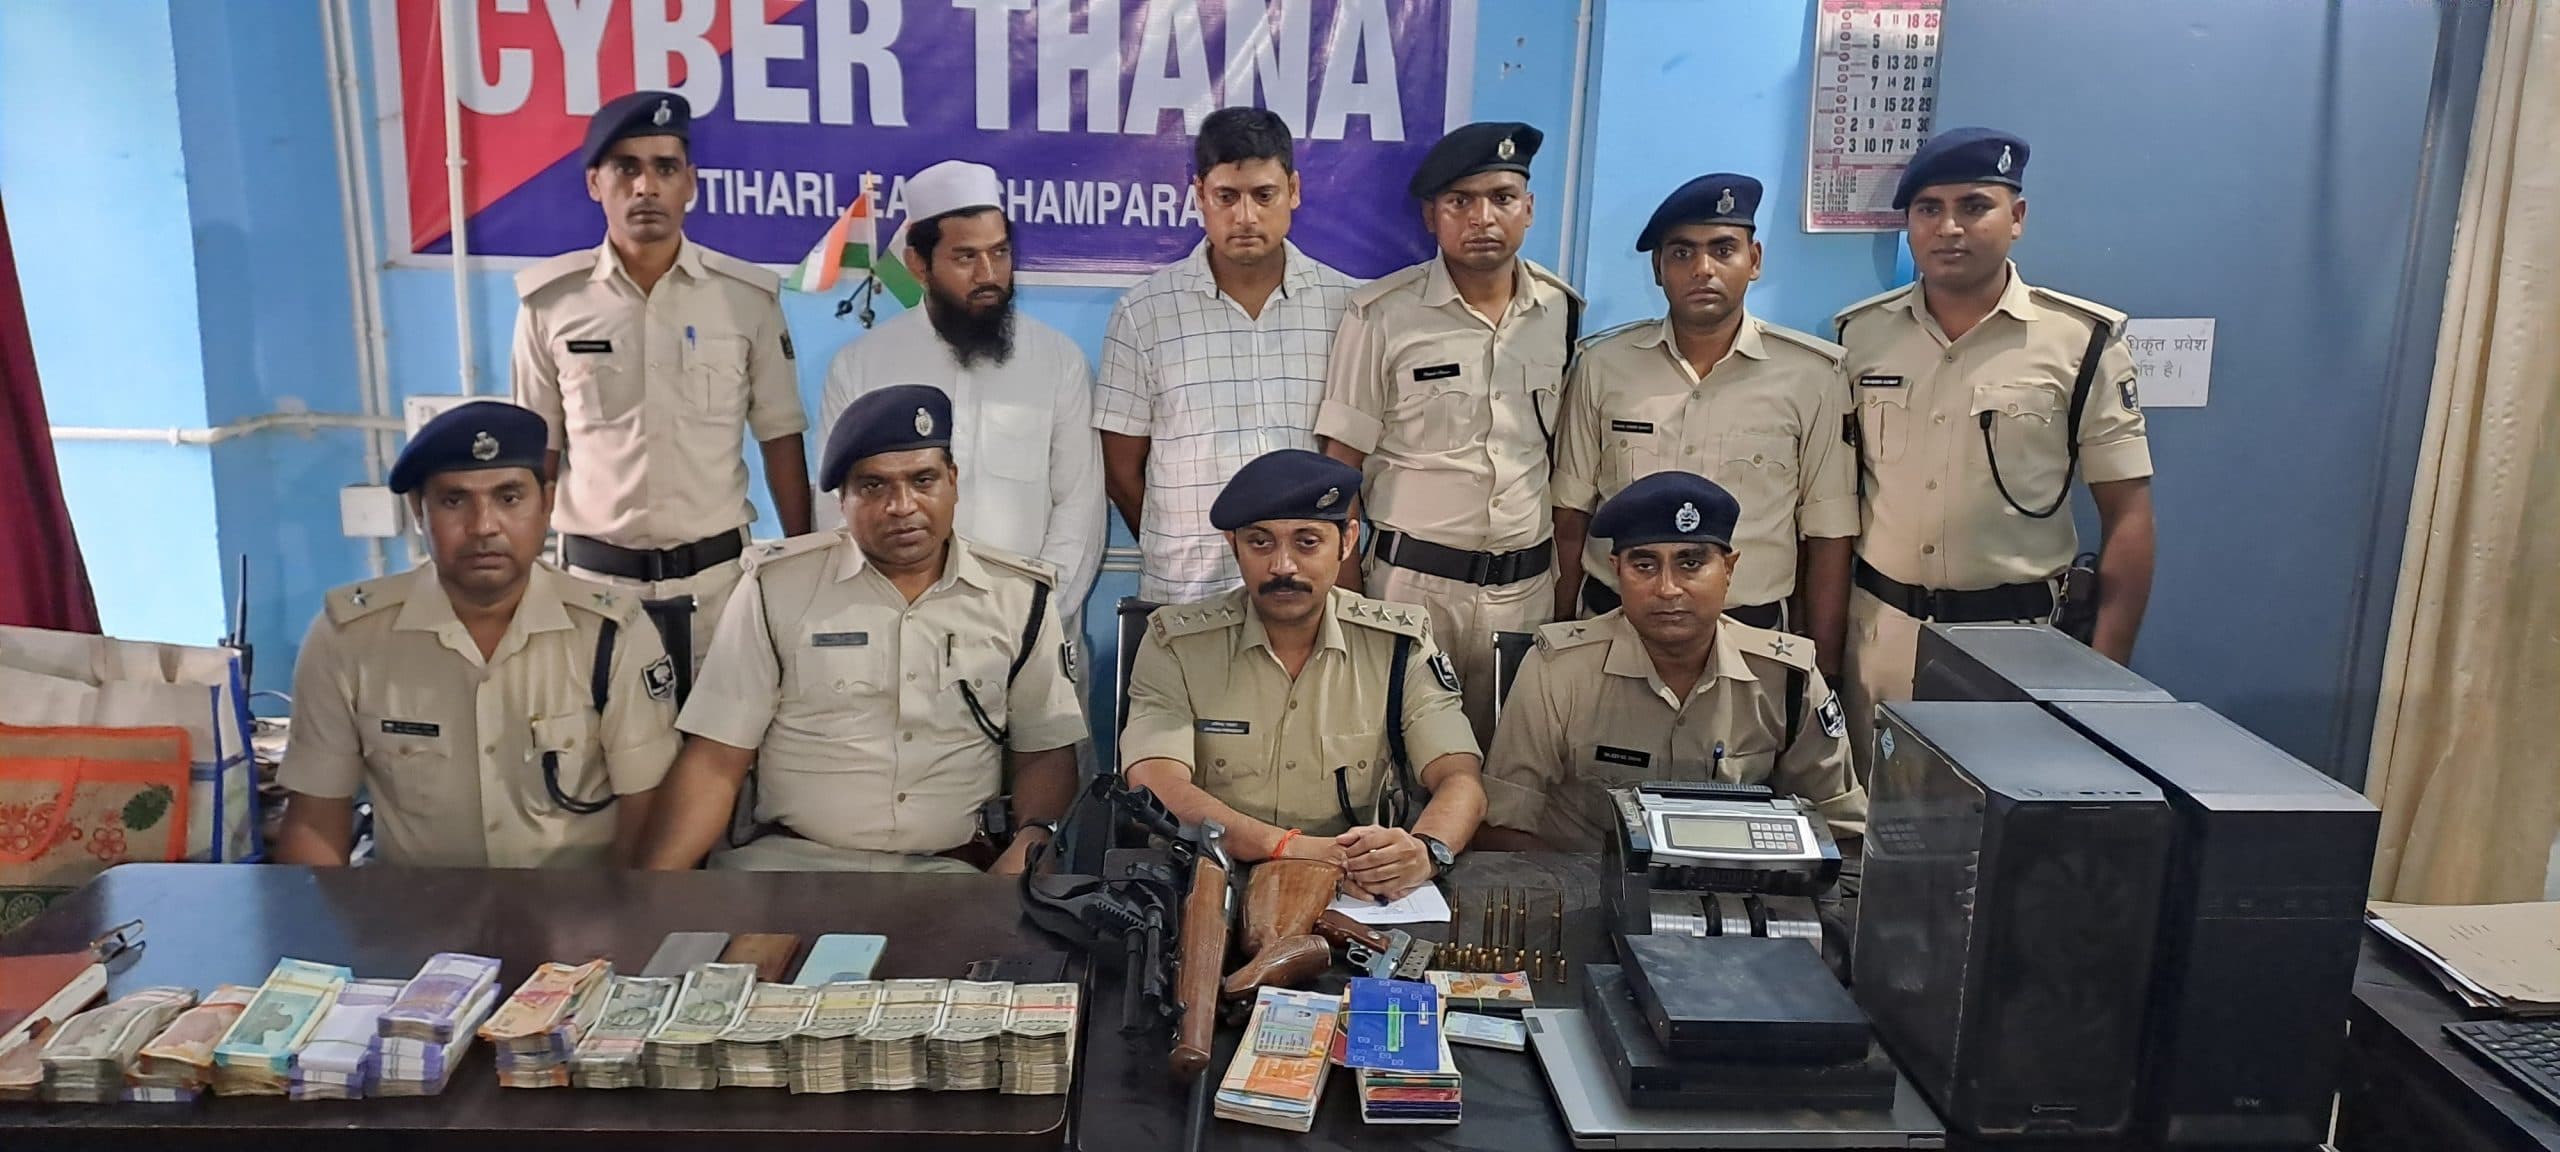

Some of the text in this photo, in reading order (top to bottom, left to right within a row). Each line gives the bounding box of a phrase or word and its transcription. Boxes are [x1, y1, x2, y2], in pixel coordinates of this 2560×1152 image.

[1873, 13, 1881, 28] 4
[1907, 13, 1919, 28] 18
[1924, 13, 1938, 28] 25
[1873, 34, 1880, 49] 5
[1906, 34, 1918, 49] 19
[1872, 55, 1879, 70] 6
[1887, 55, 1899, 70] 13
[1904, 55, 1918, 70] 20
[457, 0, 1405, 142] CYBER THANA
[1871, 76, 1879, 90] 7
[1888, 76, 1896, 88] 14
[1903, 76, 1915, 91] 21
[1885, 97, 1896, 112] 15
[1901, 97, 1914, 112] 22
[1919, 97, 1931, 112] 29
[1850, 118, 1858, 132] 2
[1917, 117, 1929, 132] 30
[1849, 138, 1857, 153] 3
[1864, 138, 1876, 153] 10
[1882, 138, 1893, 153] 17
[684, 169, 846, 217] TIHARI,
[995, 178, 1204, 228] HAMPARA
